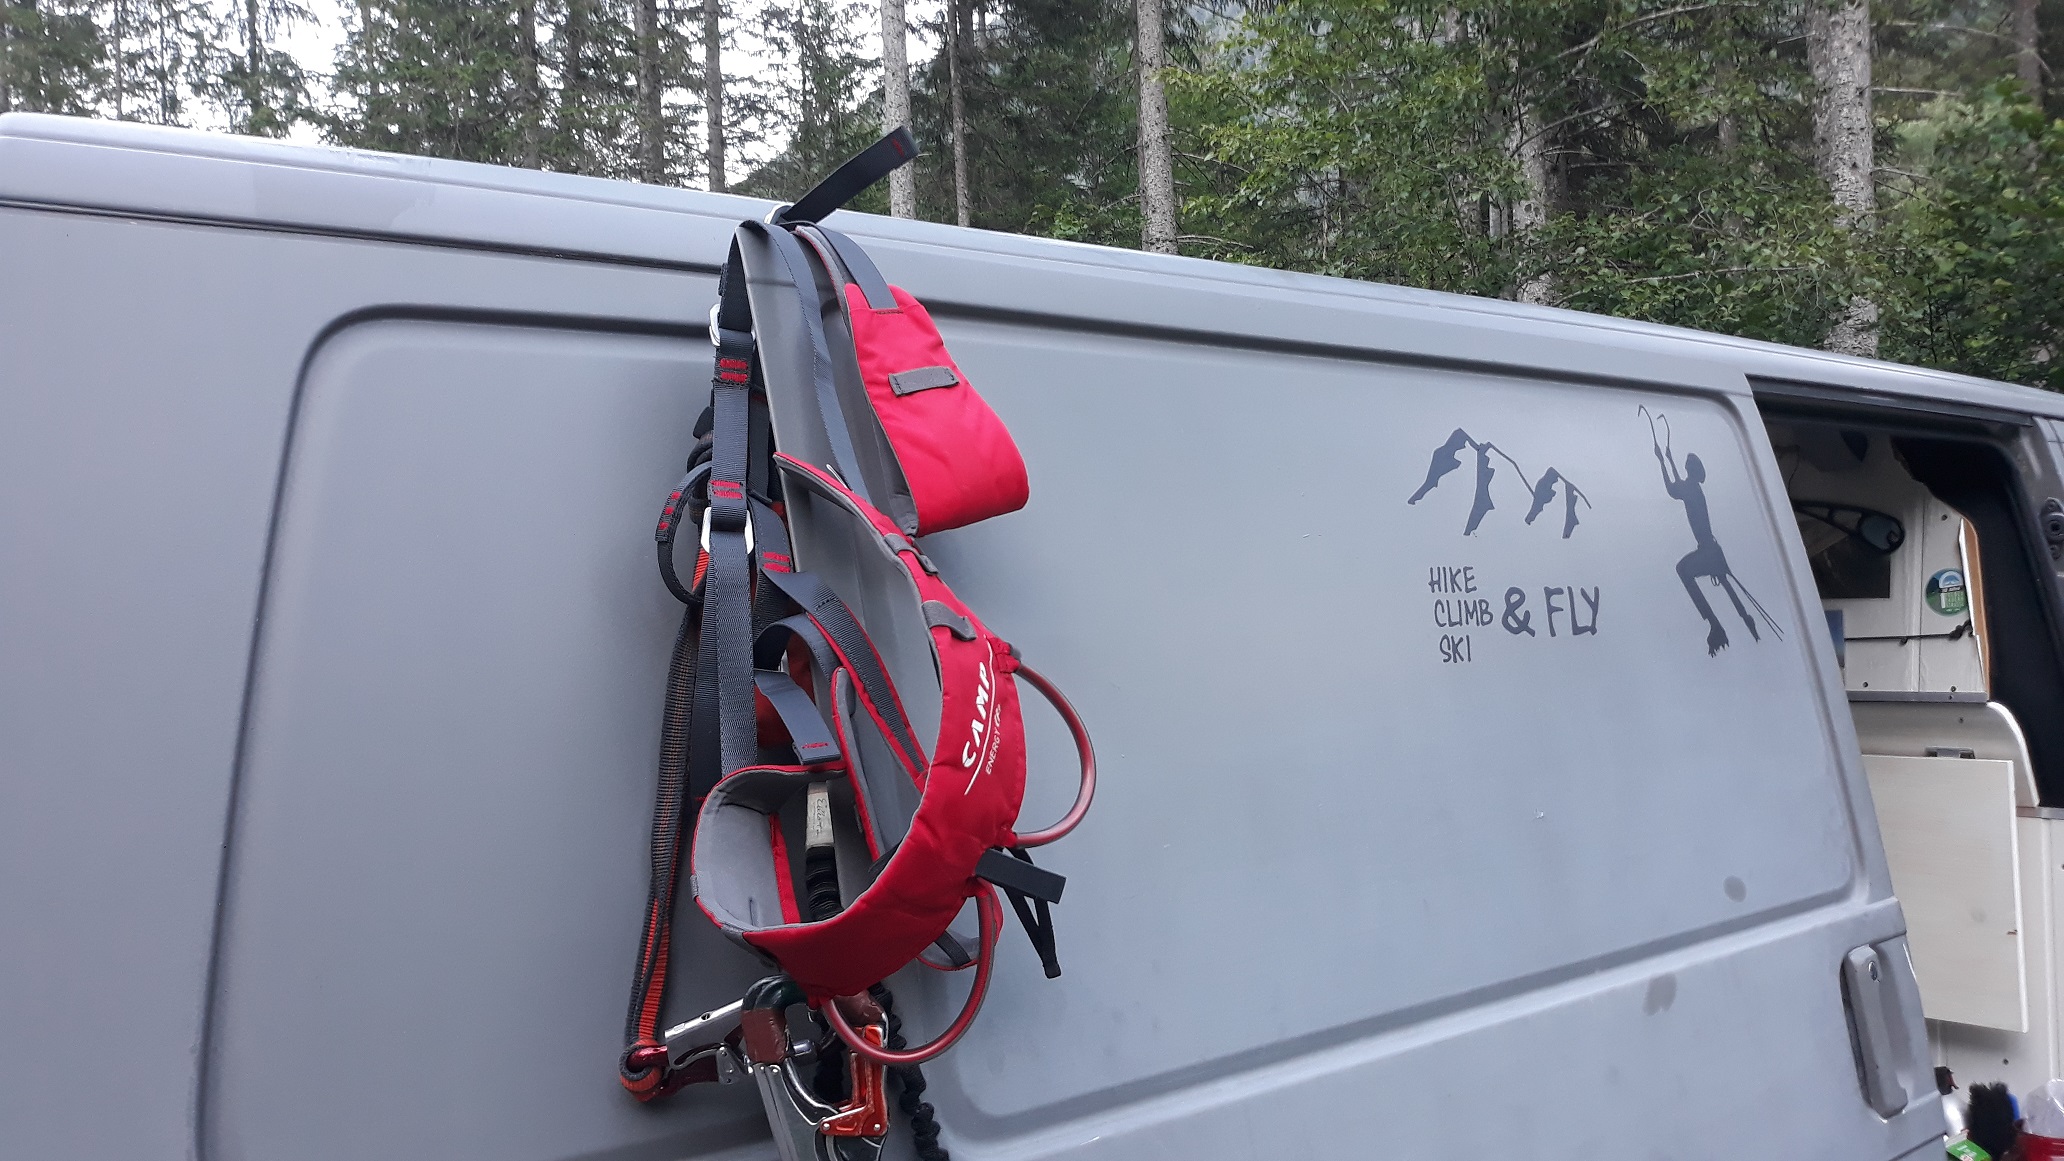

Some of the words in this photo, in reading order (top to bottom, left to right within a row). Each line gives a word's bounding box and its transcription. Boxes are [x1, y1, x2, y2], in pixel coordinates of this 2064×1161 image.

[1428, 566, 1478, 594] HIKE
[1434, 599, 1494, 628] CLIMB
[1501, 586, 1536, 638] &
[1543, 585, 1600, 638] FLY
[1439, 634, 1472, 664] SKI
[962, 661, 990, 768] CAMP
[985, 727, 1001, 775] ENERGY
